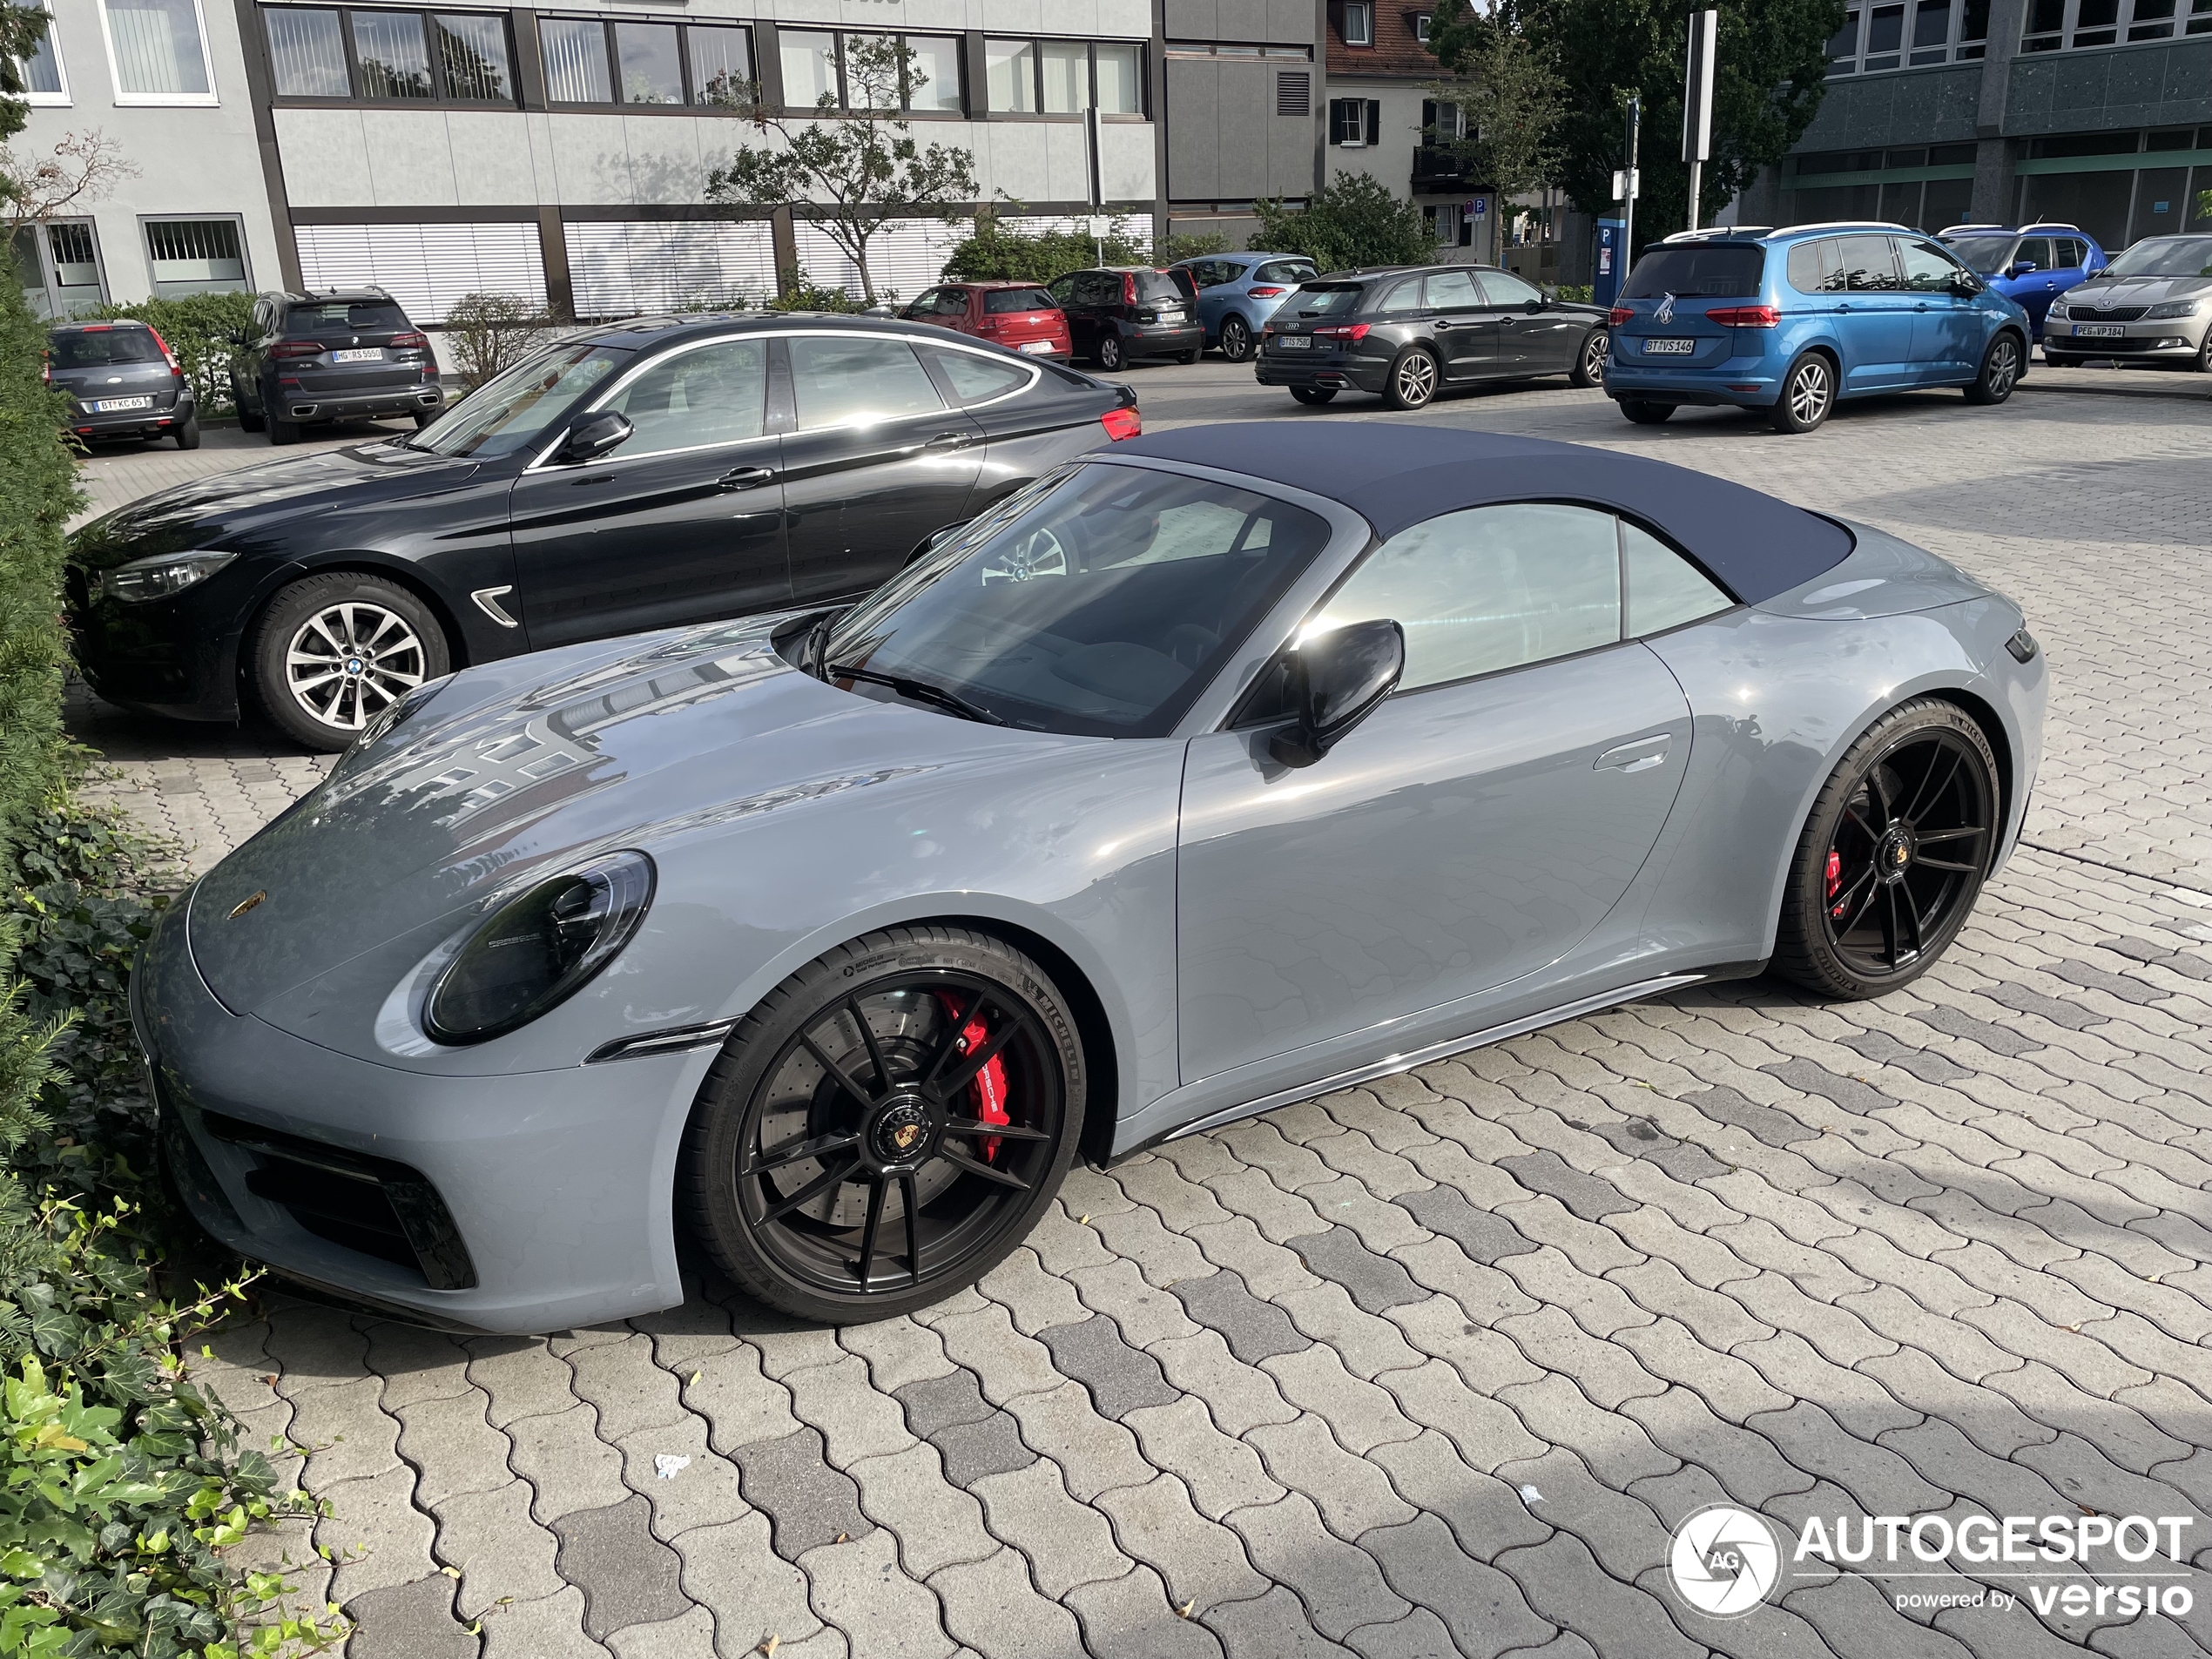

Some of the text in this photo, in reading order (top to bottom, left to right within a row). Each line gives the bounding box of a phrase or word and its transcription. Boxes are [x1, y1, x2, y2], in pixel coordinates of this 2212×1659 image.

[1602, 228, 1610, 242] P
[2078, 327, 2121, 336] PEG VP 184
[1647, 341, 1692, 352] BT VS 146
[338, 349, 381, 360] HG RS 5550
[101, 398, 143, 410] BT KC 65
[1961, 720, 1993, 765] MICHELIN
[489, 933, 540, 946] PORSCHE
[855, 954, 884, 968] MICHELIN
[868, 958, 896, 968] Performance
[1039, 995, 1080, 1080] MICHELIN
[981, 1062, 999, 1113] ORSCHE
